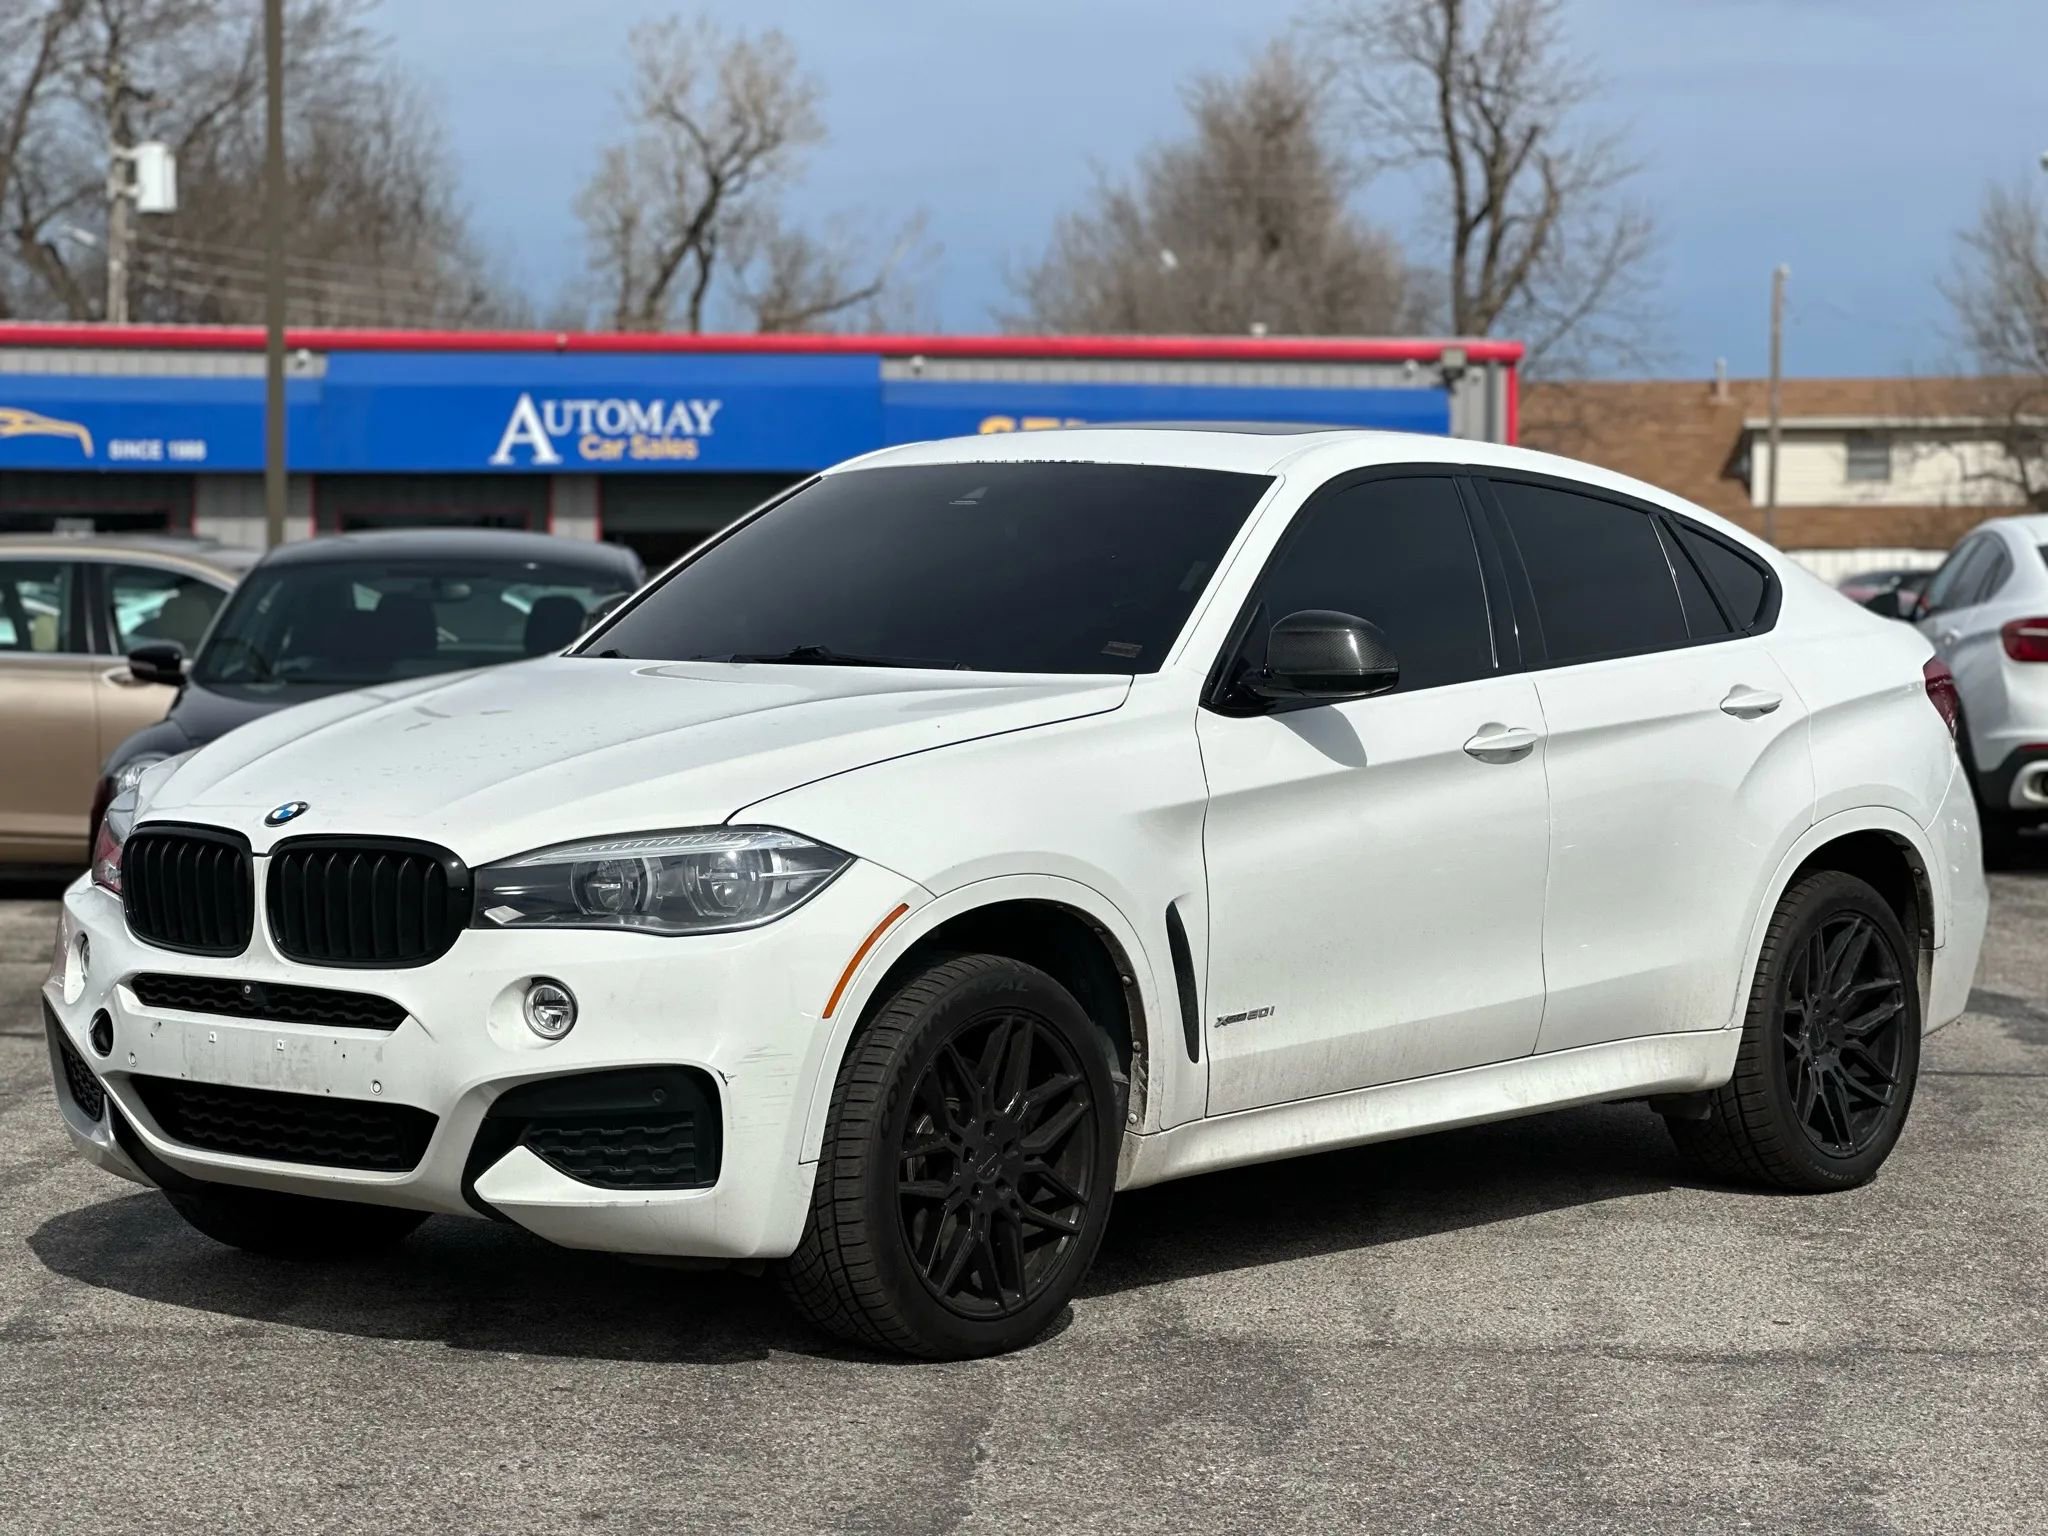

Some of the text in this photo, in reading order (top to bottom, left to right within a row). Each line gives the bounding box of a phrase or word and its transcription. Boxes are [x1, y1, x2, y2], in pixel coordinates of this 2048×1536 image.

[489, 392, 722, 465] AUTOMAY
[108, 440, 163, 461] SINCE
[579, 434, 699, 460] Car Sales
